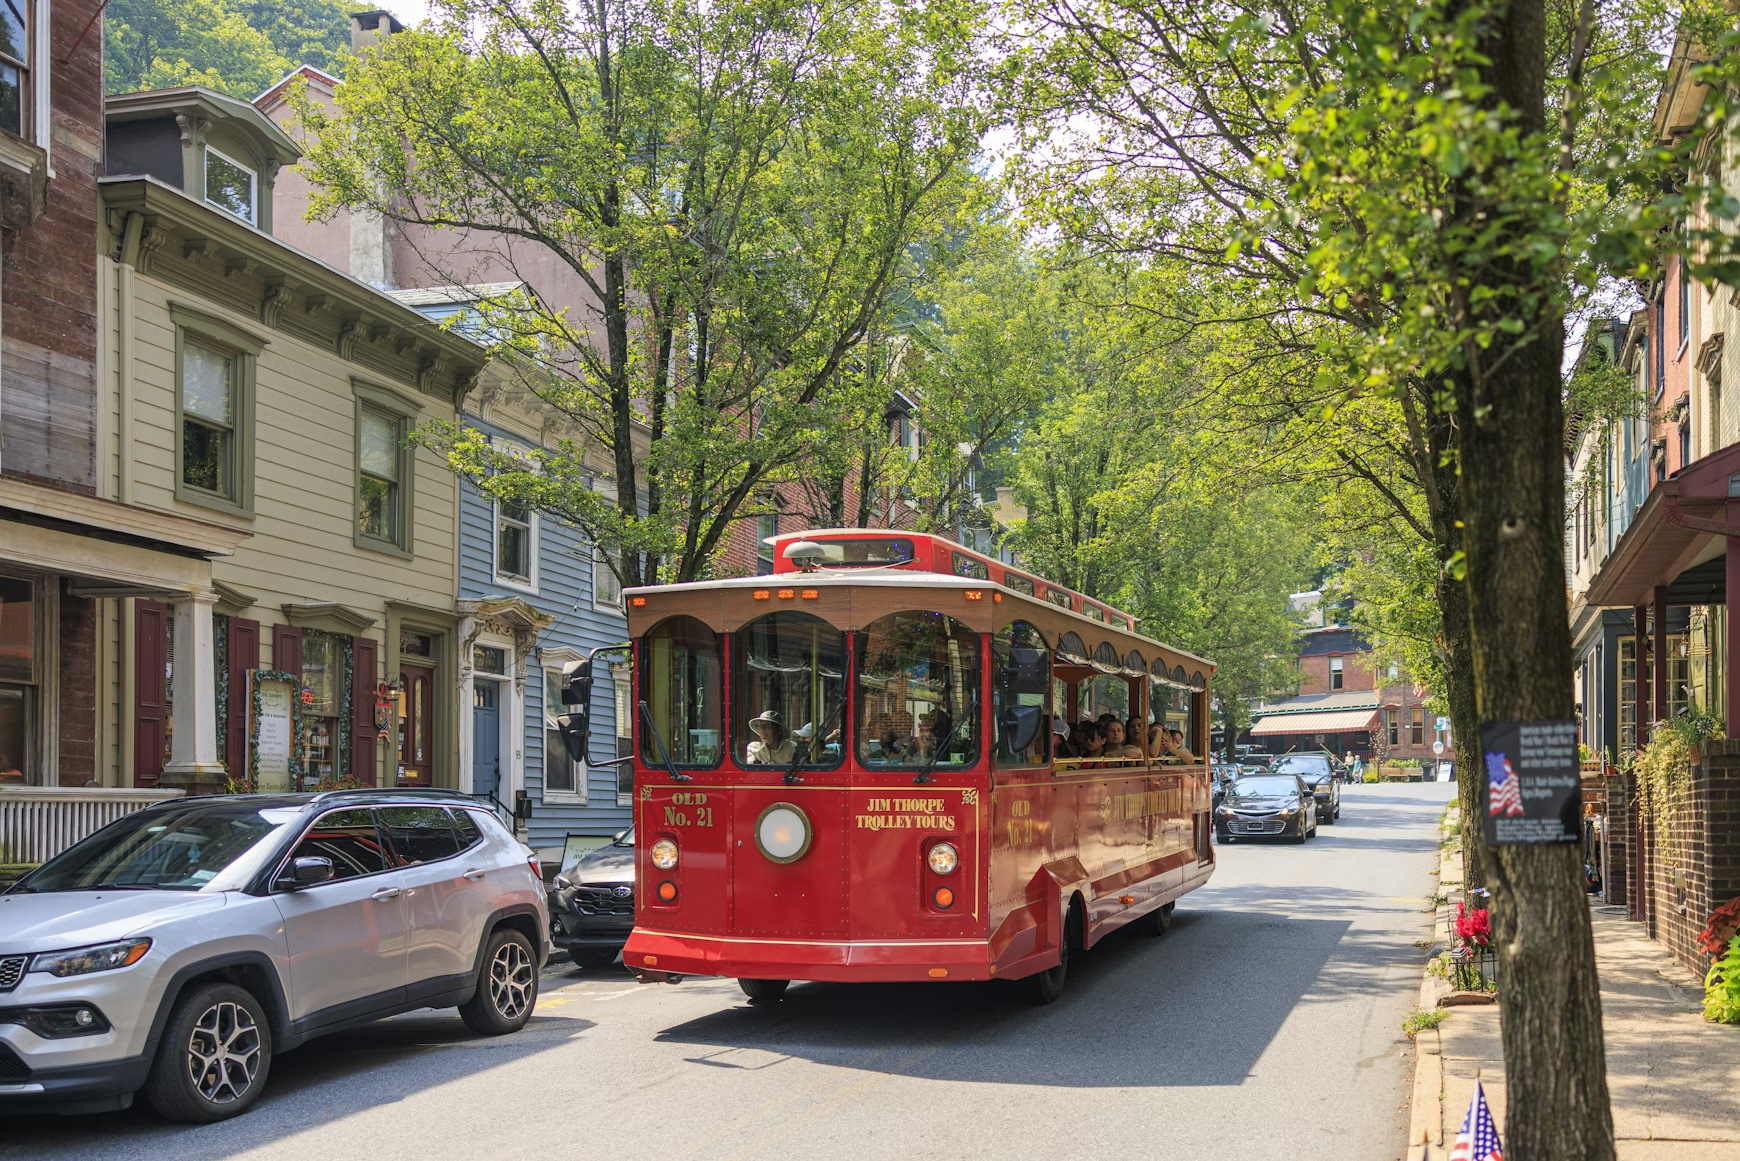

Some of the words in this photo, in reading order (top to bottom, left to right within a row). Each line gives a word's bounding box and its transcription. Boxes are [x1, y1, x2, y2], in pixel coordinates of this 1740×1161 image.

[671, 792, 707, 805] OLD
[867, 798, 891, 812] JIM
[893, 798, 945, 815] THORPE
[663, 806, 691, 826] No.
[696, 807, 713, 827] 21
[1011, 800, 1030, 817] OLD
[855, 815, 913, 831] TROLLEY
[914, 815, 956, 831] TOURS
[1007, 820, 1022, 847] No.
[1024, 818, 1033, 844] 21
